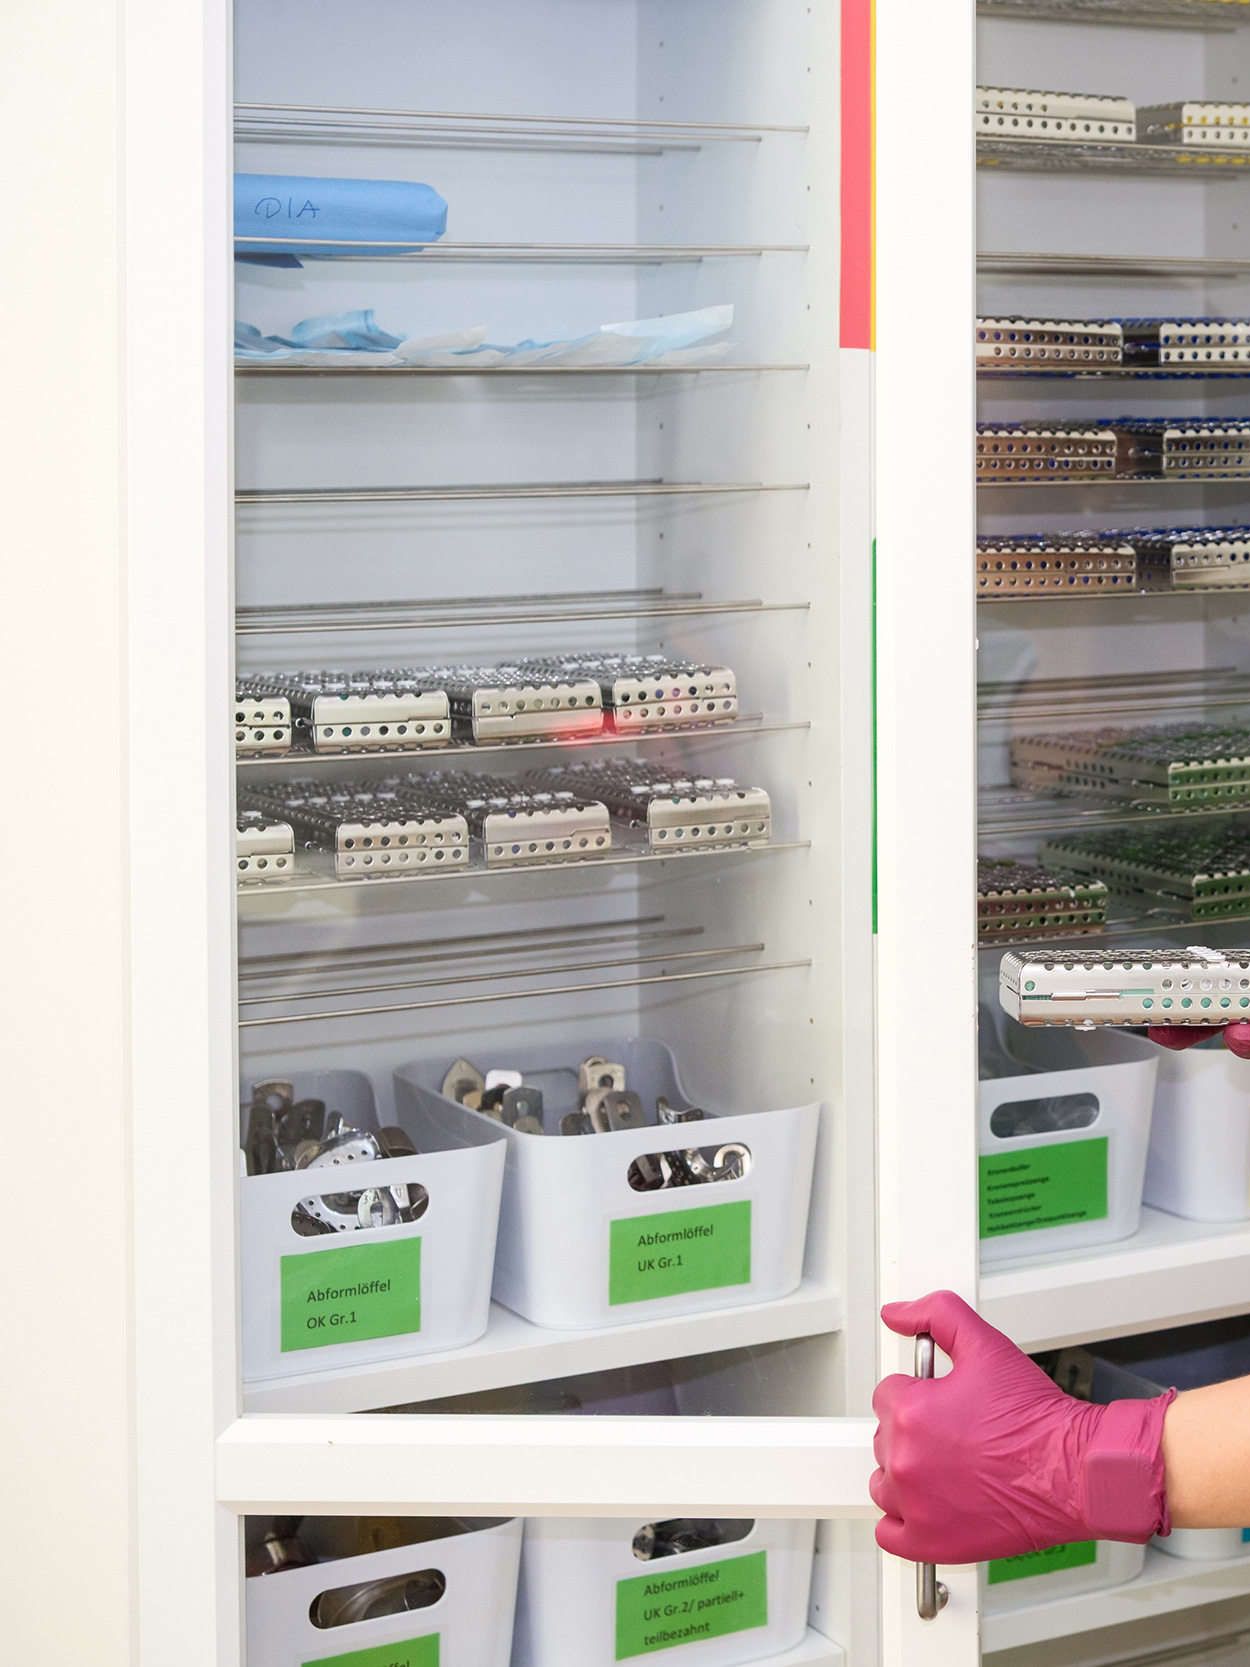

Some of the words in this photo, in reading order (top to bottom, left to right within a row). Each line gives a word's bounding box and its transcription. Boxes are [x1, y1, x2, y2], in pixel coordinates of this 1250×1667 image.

[255, 197, 320, 219] DIA
[637, 1224, 714, 1247] Abformlöffel
[637, 1258, 655, 1272] UK
[658, 1254, 683, 1269] Gr.1
[306, 1278, 391, 1303] Abformlöffel
[306, 1315, 326, 1329] OK
[329, 1311, 357, 1326] Gr.1
[643, 1569, 720, 1597] Abformlöffel
[643, 1607, 661, 1621] UK
[643, 1622, 710, 1646] teilbezahnt
